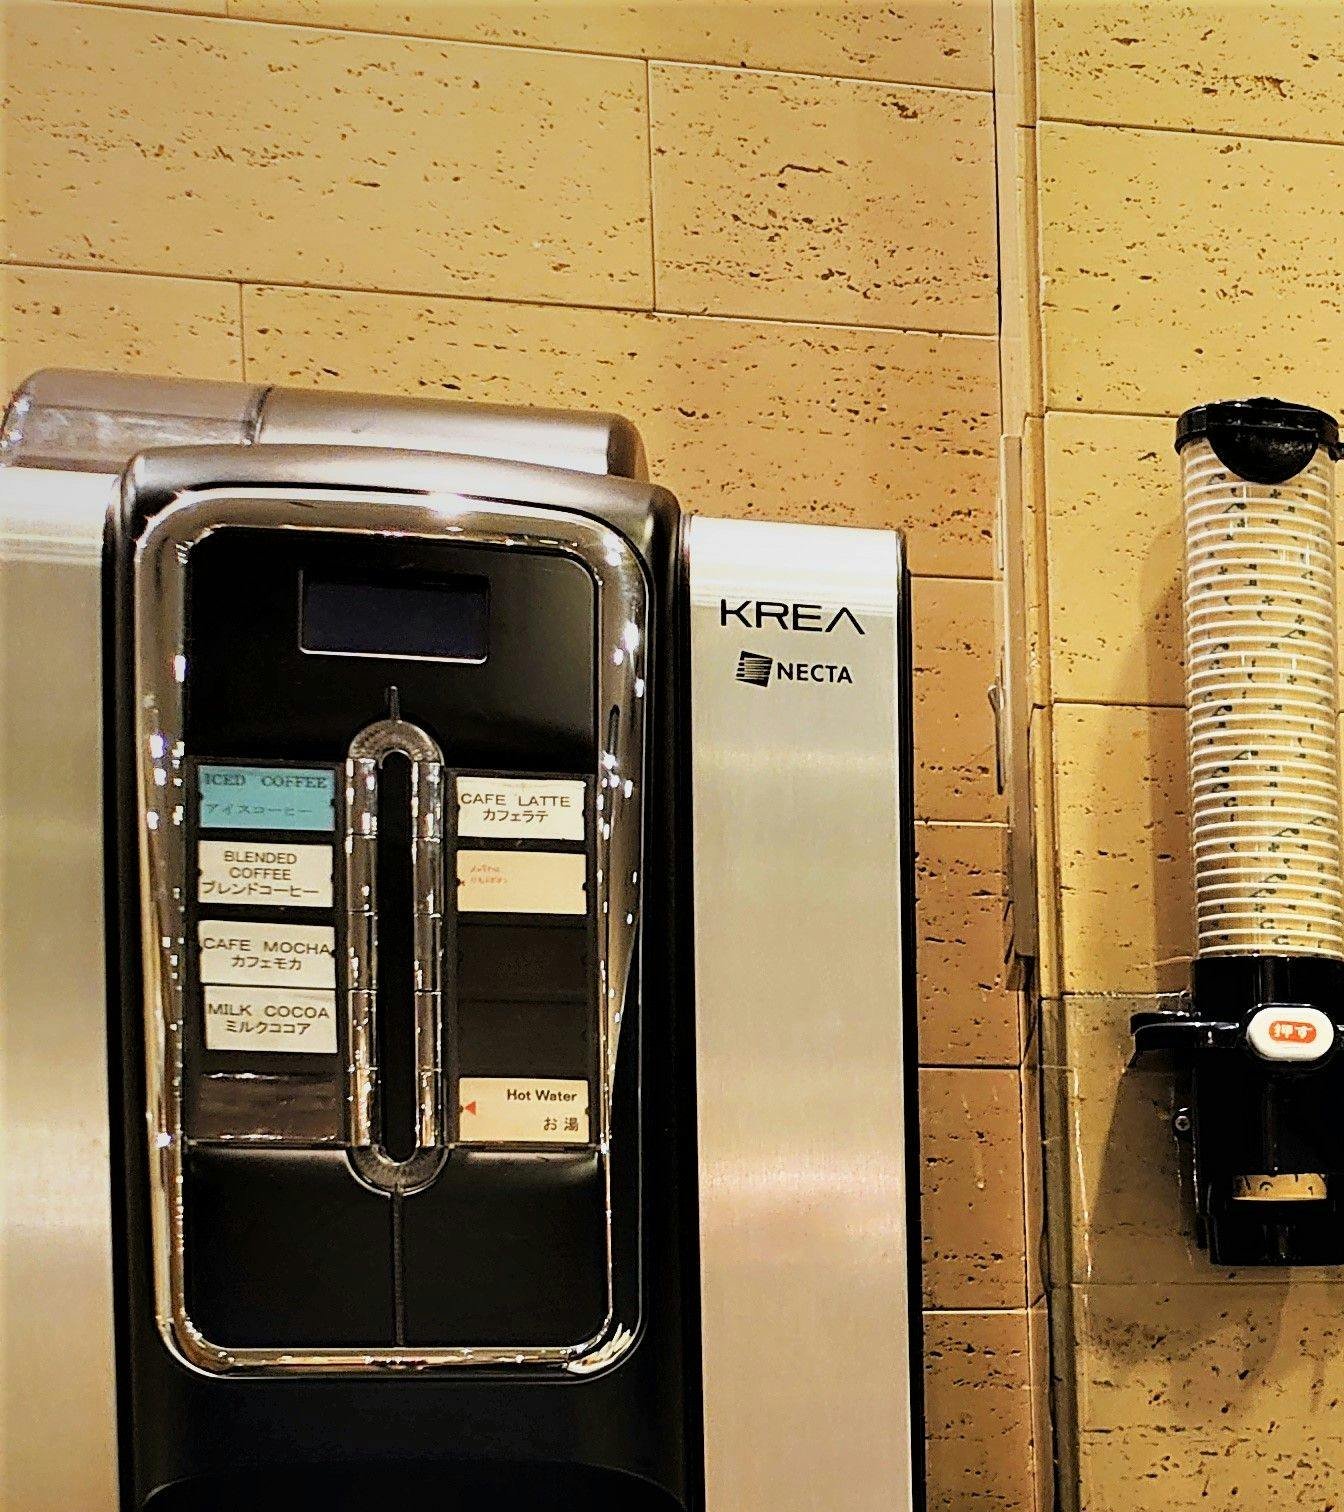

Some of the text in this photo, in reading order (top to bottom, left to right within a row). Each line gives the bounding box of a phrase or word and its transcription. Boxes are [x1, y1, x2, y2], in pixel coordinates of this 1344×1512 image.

[720, 599, 866, 635] KREA
[777, 662, 853, 684] NECTA
[204, 774, 327, 789] ICED COFFEE
[461, 793, 571, 807] CAFE LATTE
[206, 803, 312, 816] アイスコーヒー
[483, 808, 548, 823] カフェラテ
[224, 850, 298, 865] BLENDED
[229, 866, 292, 881] COFFEE
[202, 880, 319, 898] ブレンドコーヒー
[203, 937, 331, 955] CAFE MOCHA
[231, 954, 302, 970] カフェモカ
[208, 1003, 330, 1019] MILK COCOA
[225, 1020, 311, 1035] ミルクココア
[507, 1088, 578, 1102] Hot Water
[543, 1117, 579, 1132] お湯
